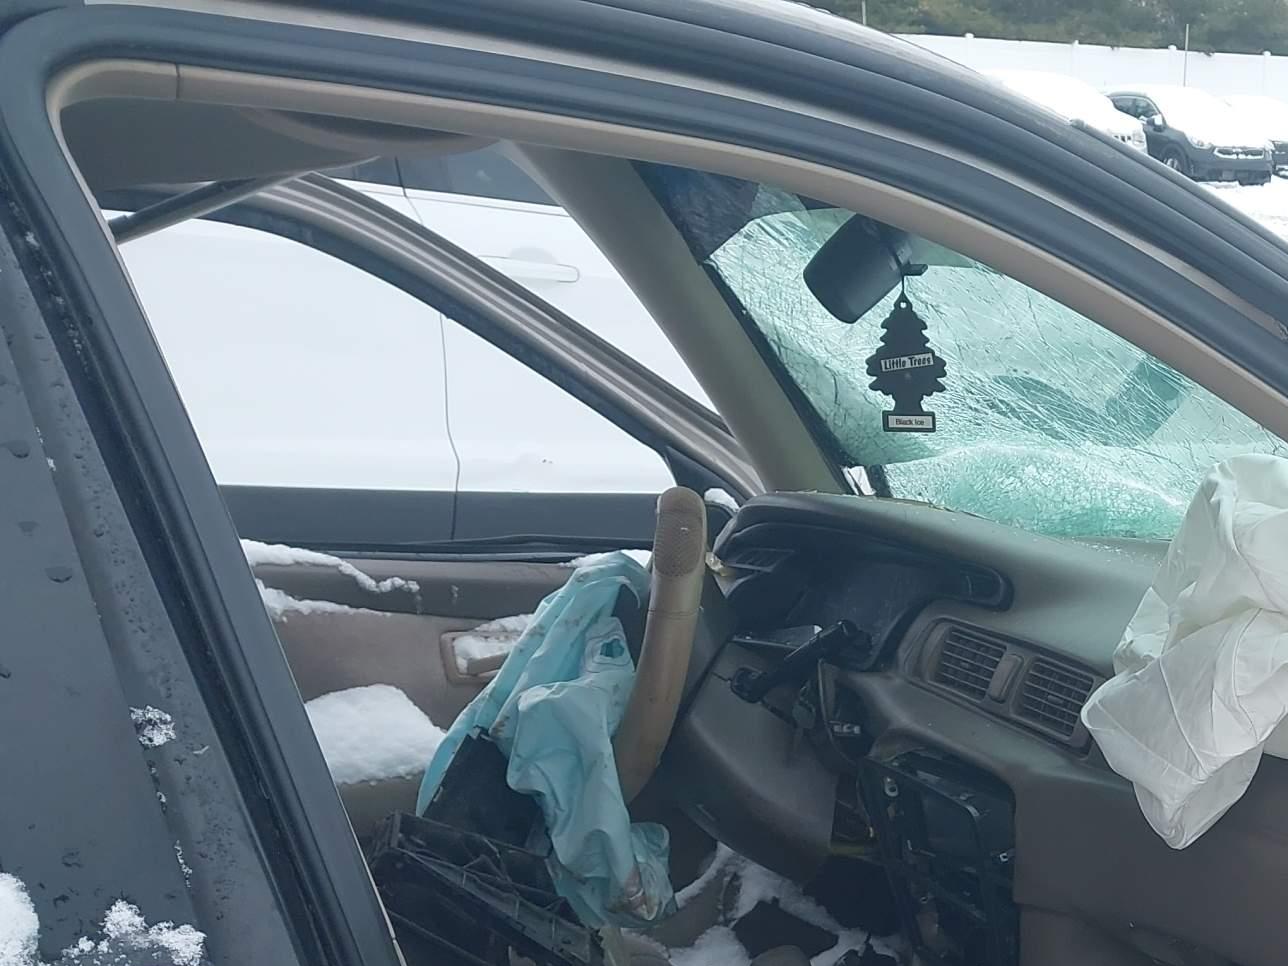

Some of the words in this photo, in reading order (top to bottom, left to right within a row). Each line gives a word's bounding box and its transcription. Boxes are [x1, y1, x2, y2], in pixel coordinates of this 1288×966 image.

[884, 358, 907, 370] Little
[908, 356, 932, 367] Trees
[895, 418, 913, 426] Black
